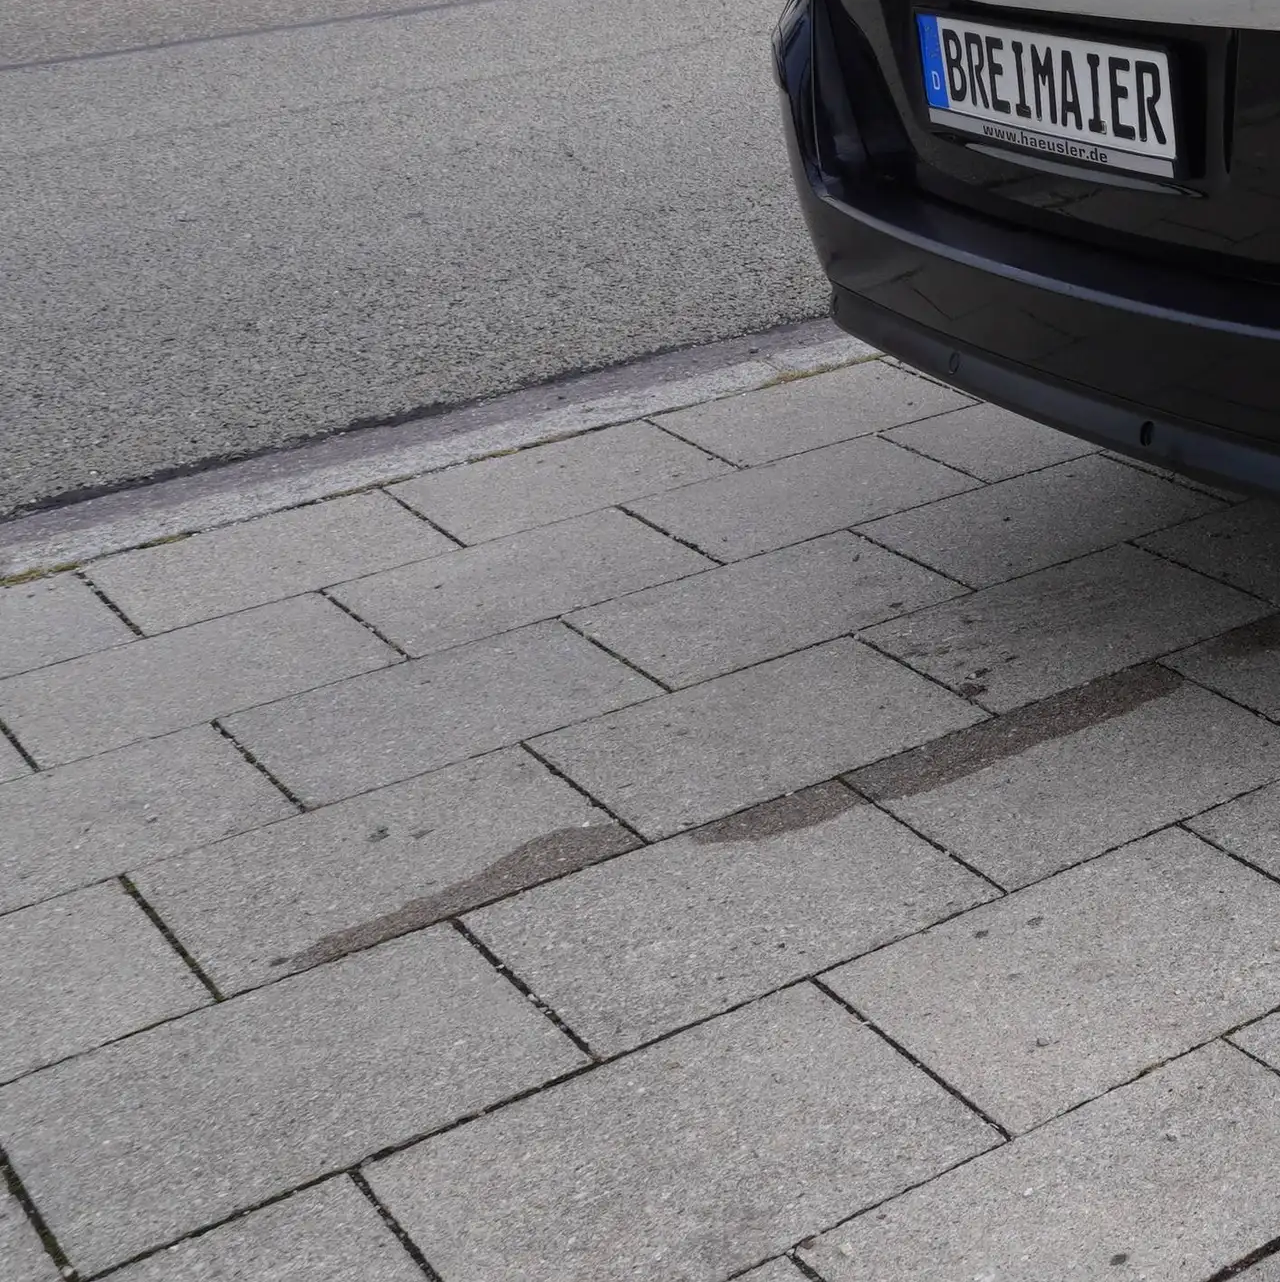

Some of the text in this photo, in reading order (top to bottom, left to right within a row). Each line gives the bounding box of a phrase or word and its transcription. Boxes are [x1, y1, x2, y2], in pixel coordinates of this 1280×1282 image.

[932, 71, 941, 90] D
[942, 29, 1166, 145] BREIMAIER
[983, 124, 1108, 162] www.haeusler.de
